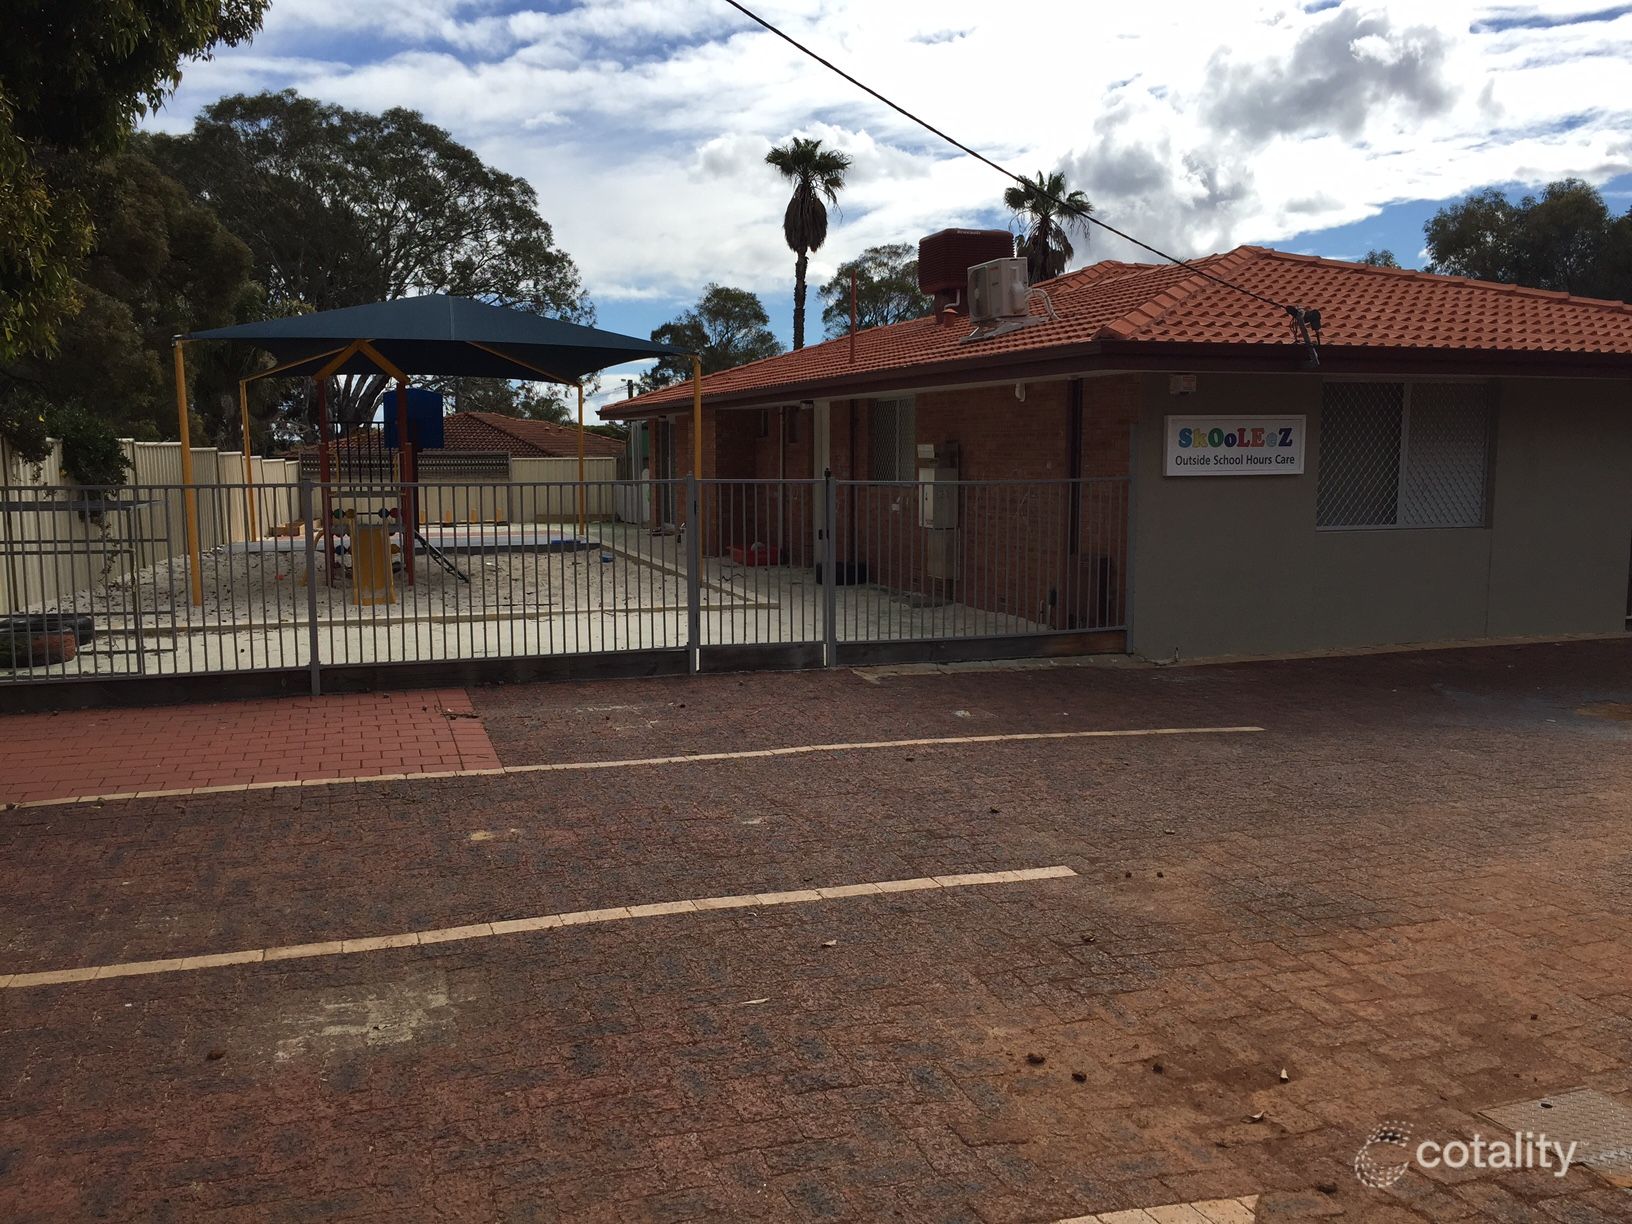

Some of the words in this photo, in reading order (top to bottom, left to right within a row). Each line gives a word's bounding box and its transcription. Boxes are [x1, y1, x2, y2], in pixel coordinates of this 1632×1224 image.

[1175, 454, 1211, 466] Outside
[1213, 454, 1244, 465] School
[1246, 454, 1273, 465] Hours
[1275, 454, 1295, 465] Care
